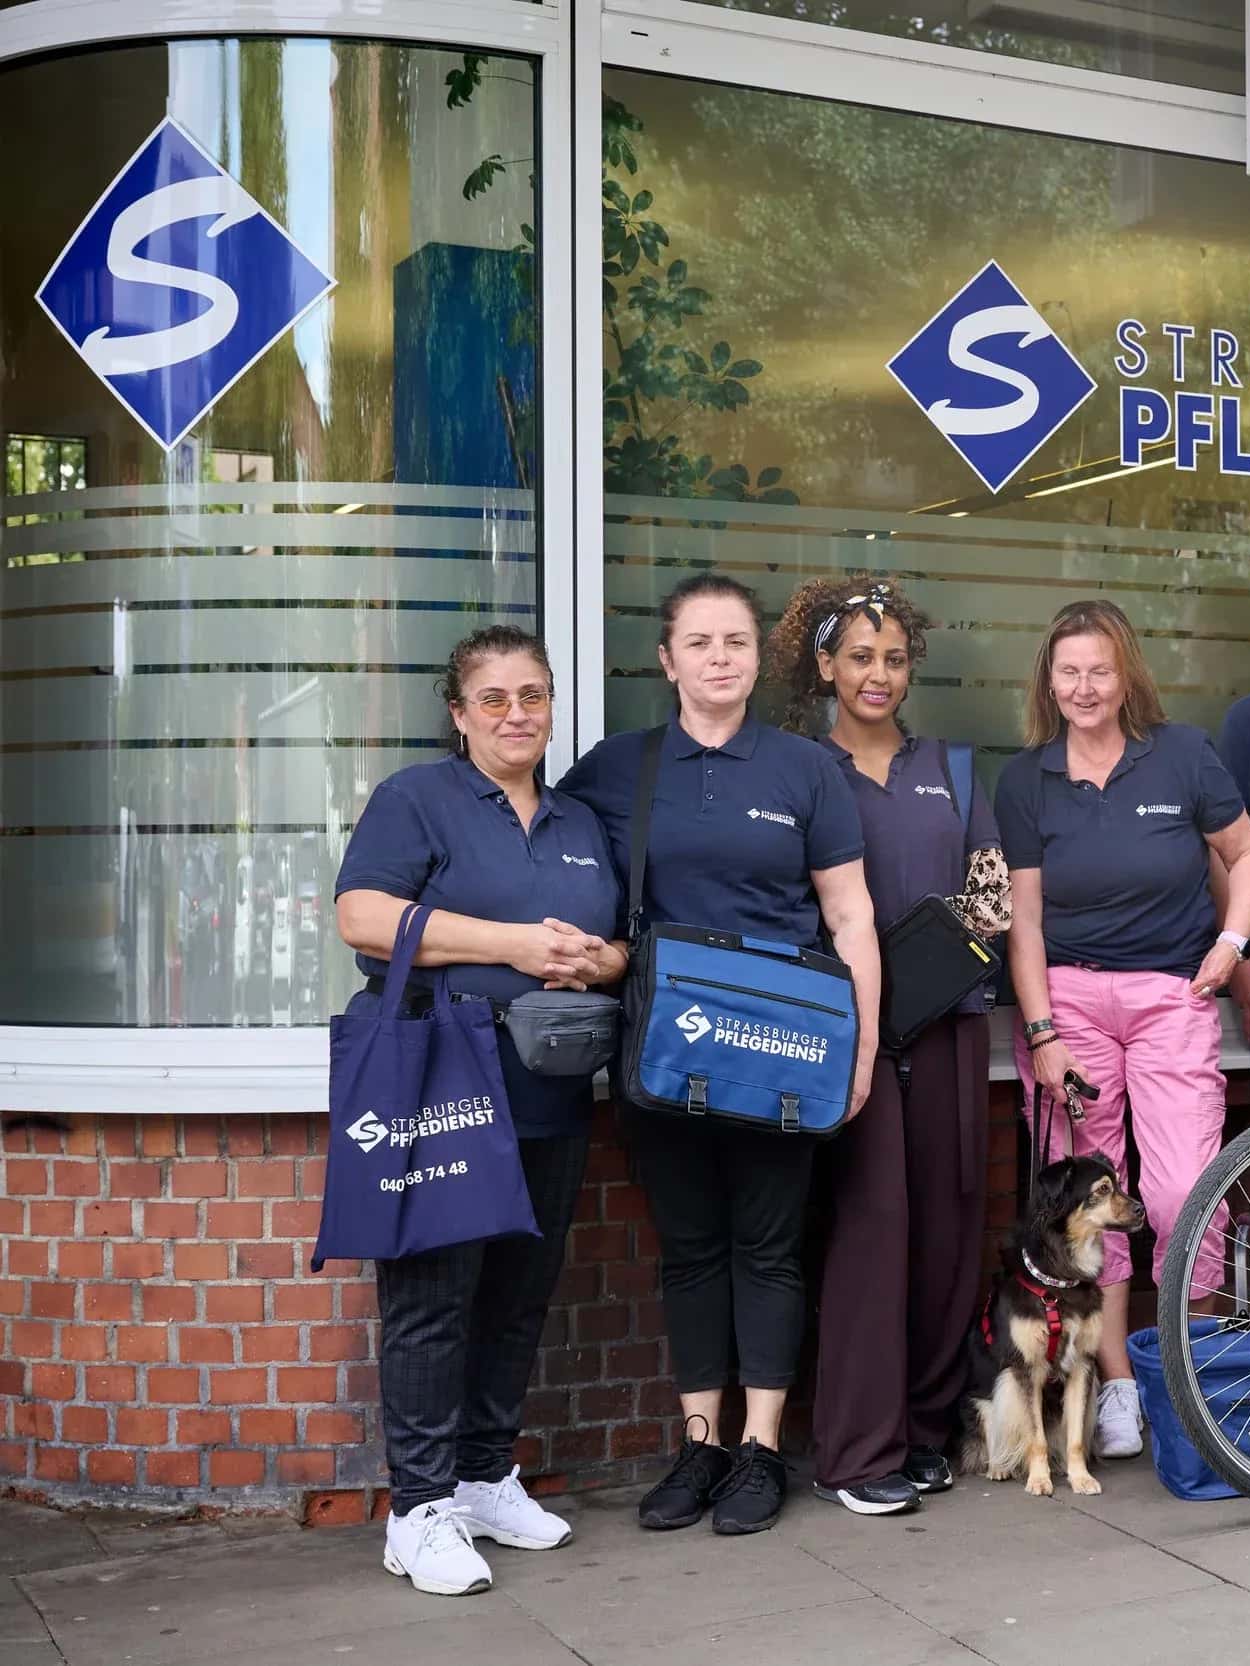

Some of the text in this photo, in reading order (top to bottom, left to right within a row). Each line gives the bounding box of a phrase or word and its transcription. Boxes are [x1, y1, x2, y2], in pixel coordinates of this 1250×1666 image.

[714, 1029, 827, 1064] PFLEGEDIENST
[715, 1016, 828, 1049] STRASSBURGER
[380, 1160, 468, 1192] 040 68 74 48
